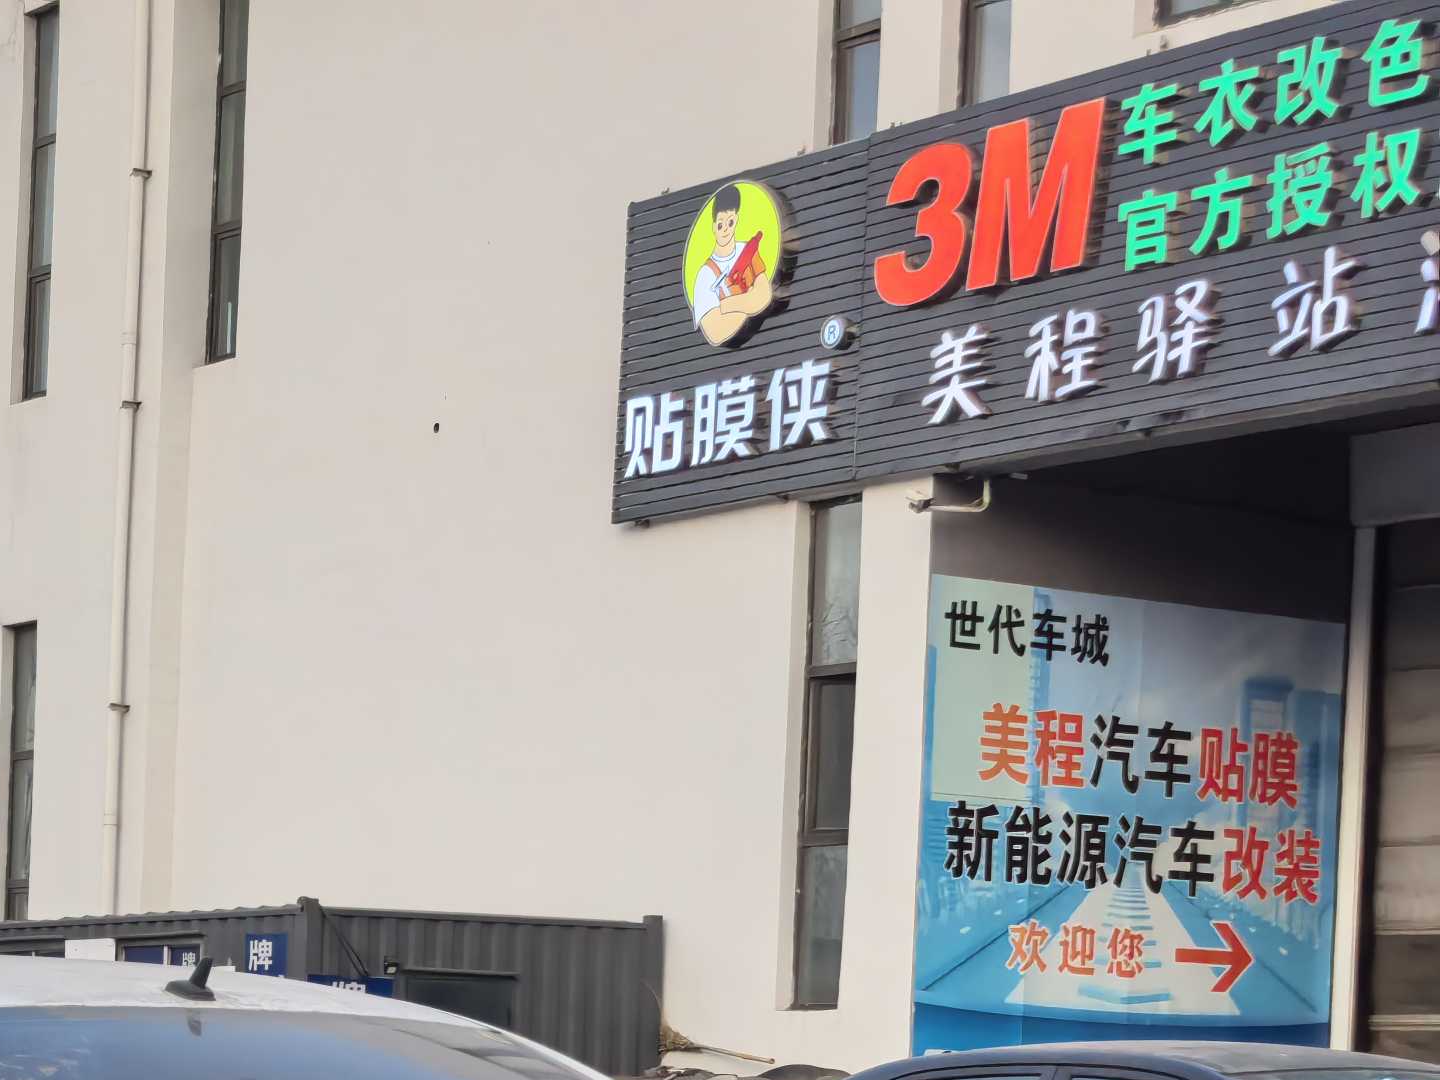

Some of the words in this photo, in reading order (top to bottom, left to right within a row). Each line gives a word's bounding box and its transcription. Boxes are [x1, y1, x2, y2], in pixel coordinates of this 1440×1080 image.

[1117, 19, 1430, 165] 车衣改色
[874, 98, 1106, 307] 3M
[1117, 128, 1421, 272] 官方授权
[921, 229, 1440, 424] 美程驿站
[623, 358, 833, 479] 贴膜侠
[944, 600, 1110, 667] 世代车城
[978, 702, 1299, 808] 美程汽车贴膜
[943, 800, 1322, 904] 新能源汽车改装
[249, 939, 273, 971] 牌
[1006, 919, 1145, 979] 欢迎您
